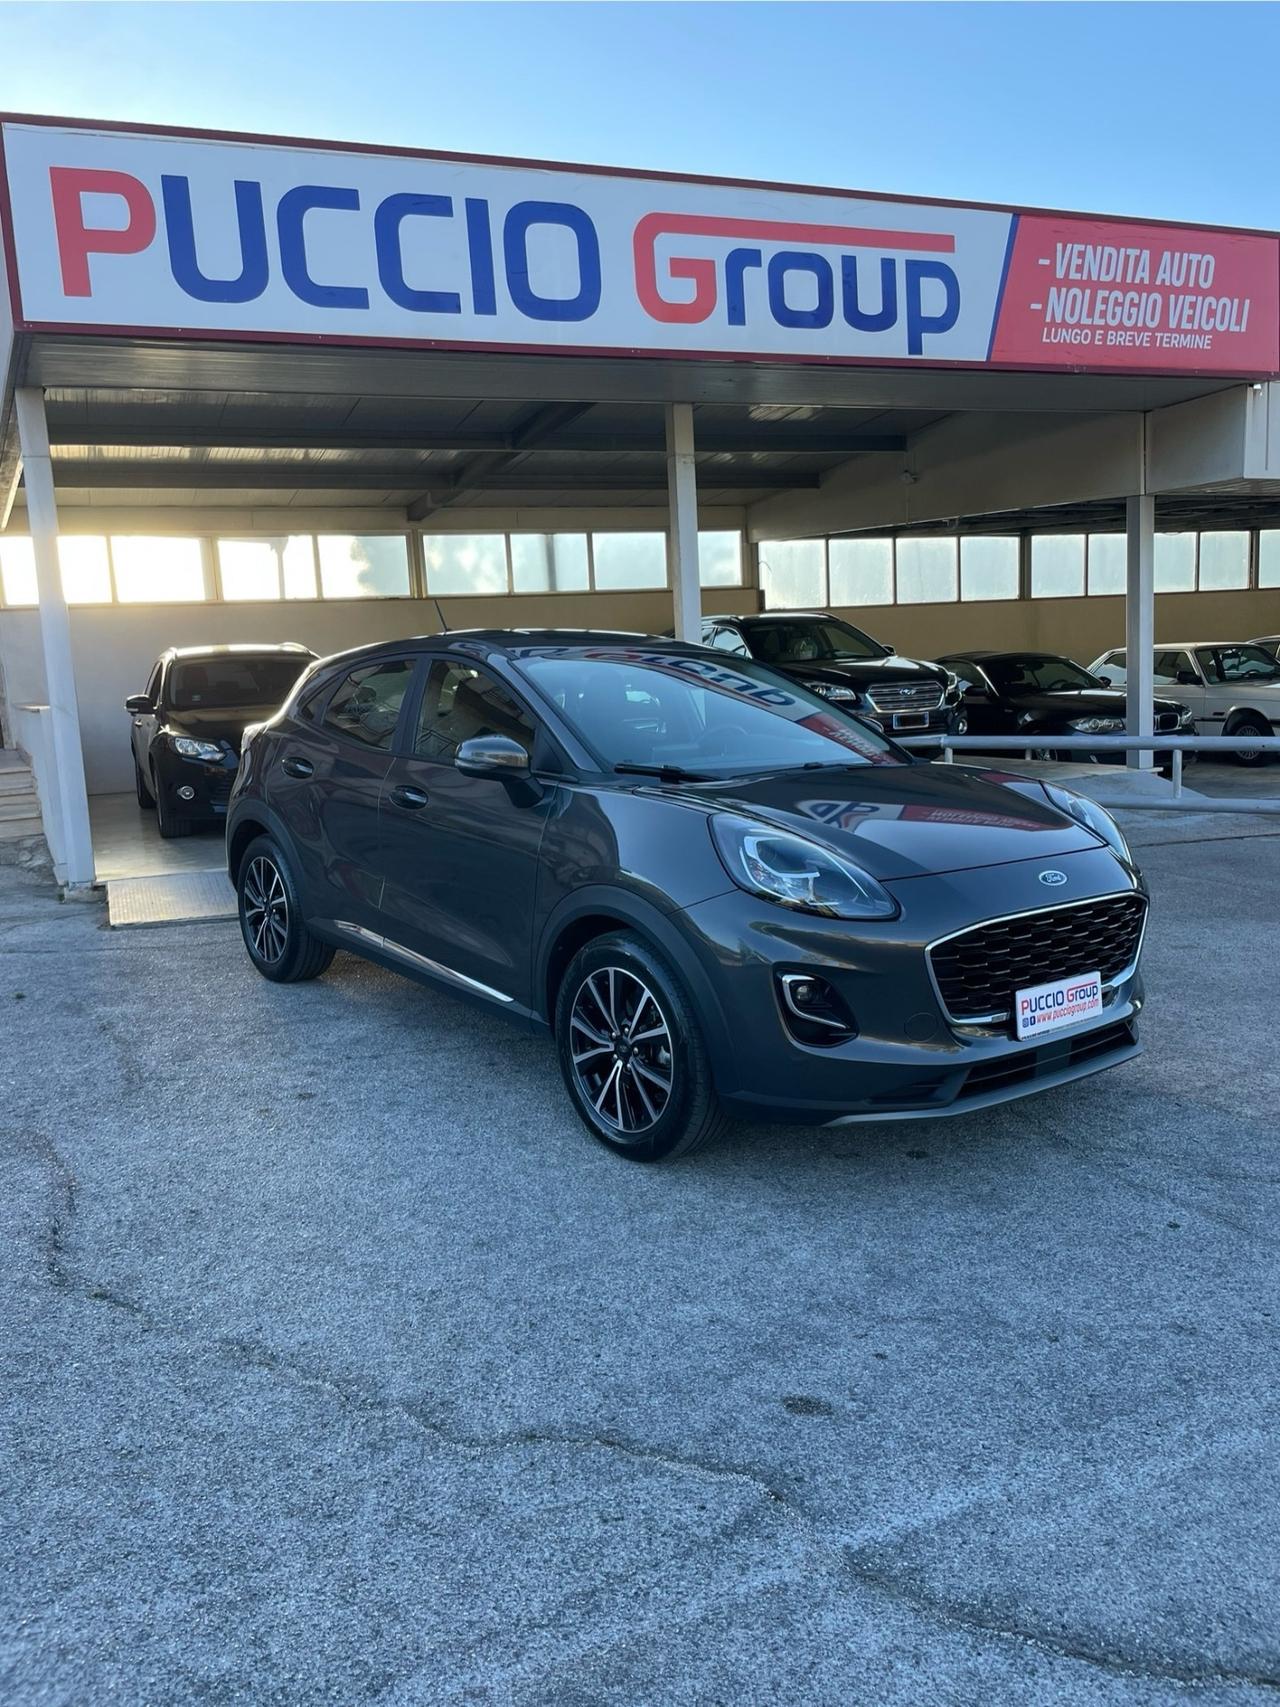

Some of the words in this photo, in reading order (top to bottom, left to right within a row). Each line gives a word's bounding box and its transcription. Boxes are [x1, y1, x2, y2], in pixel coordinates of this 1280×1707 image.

[49, 166, 602, 322] PUCCIO
[633, 212, 961, 356] Group
[1055, 242, 1150, 285] VENDITA
[1155, 251, 1216, 289] AUTO
[1045, 287, 1163, 329] NOLEGGIO
[1168, 294, 1250, 332] VEICOLI
[1042, 327, 1091, 345] LUNGO
[1094, 330, 1104, 345] E
[1106, 330, 1152, 347] BREVE
[1155, 332, 1213, 350] TERMINE
[1021, 990, 1065, 1016] PUCCIO
[1067, 981, 1099, 1003] Group
